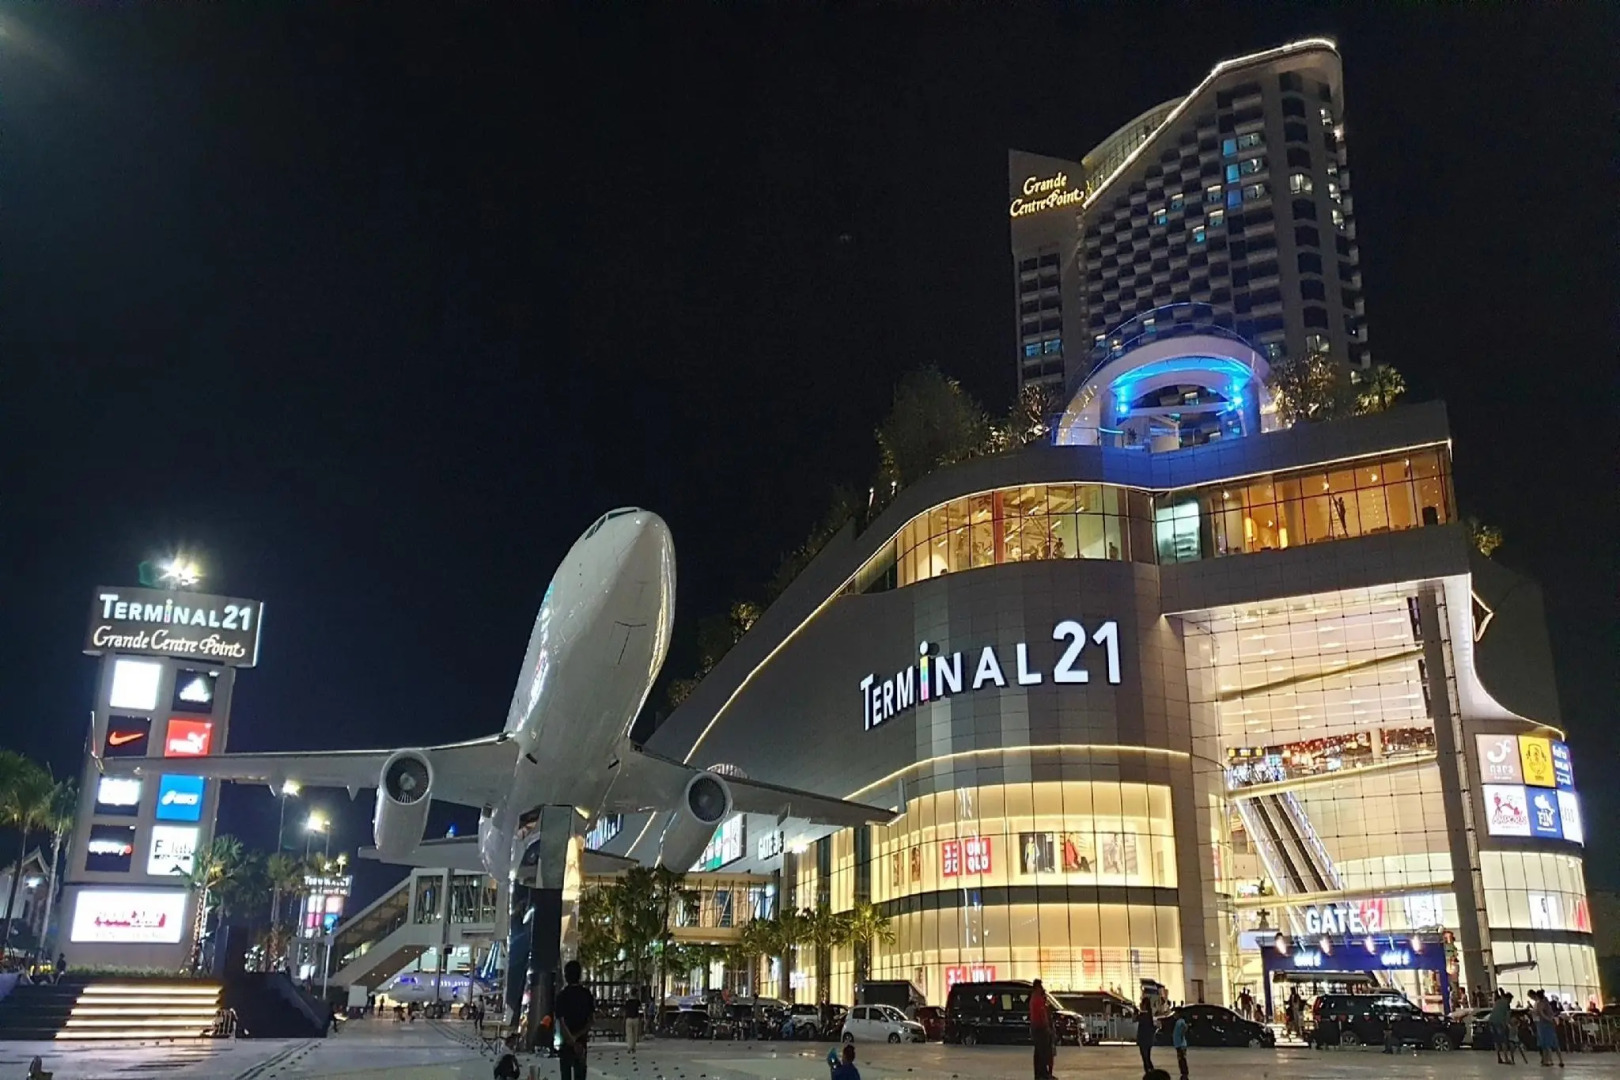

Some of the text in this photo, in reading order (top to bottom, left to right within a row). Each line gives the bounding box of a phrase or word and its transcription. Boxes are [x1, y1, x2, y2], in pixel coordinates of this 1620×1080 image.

[1023, 171, 1067, 195] Grande
[1010, 188, 1085, 217] Centre Point
[93, 626, 246, 658] Grande Centre Point
[1052, 620, 1121, 684] 21
[1305, 908, 1381, 935] GATE 2
